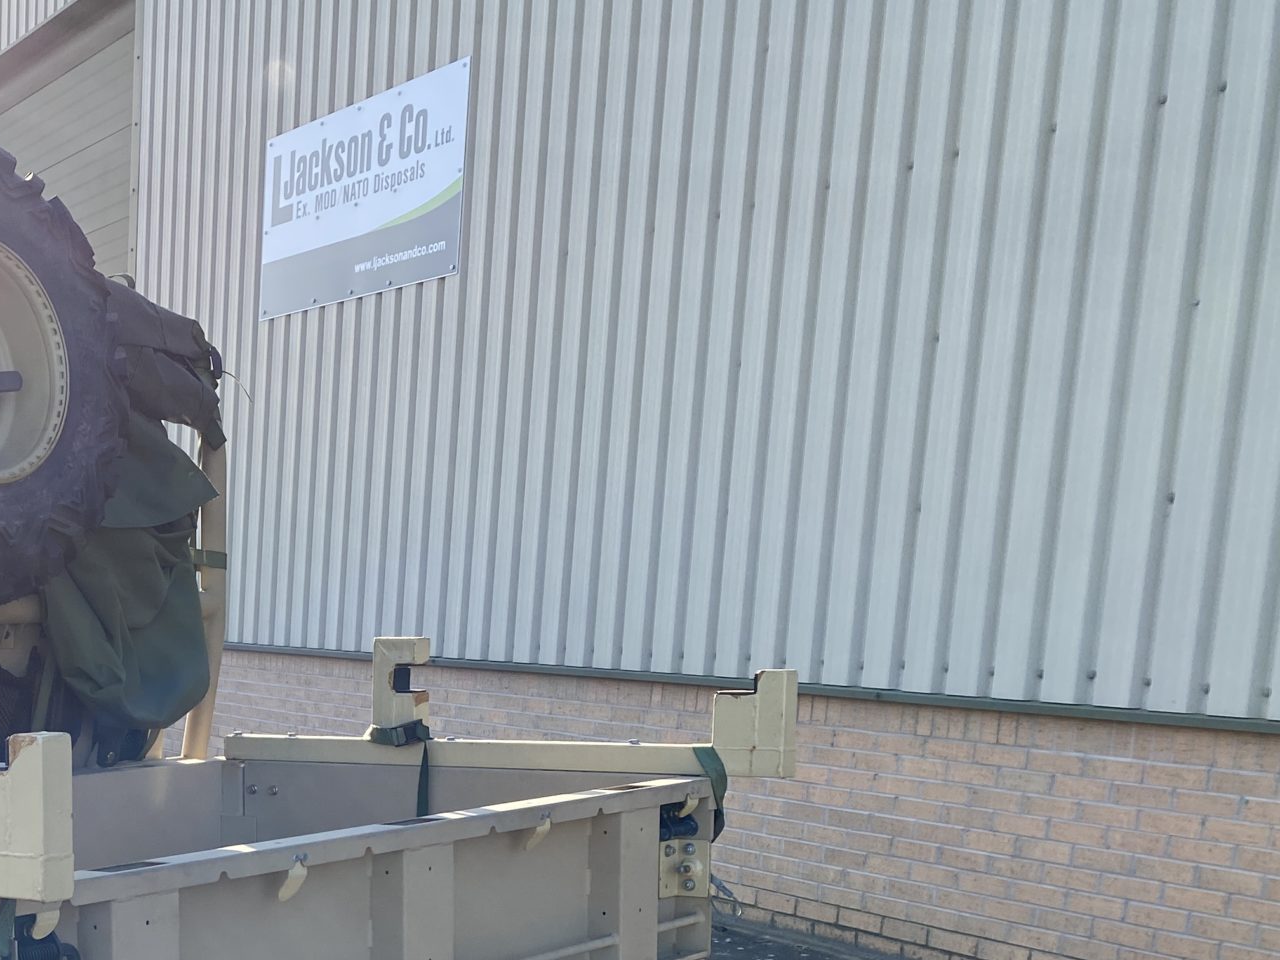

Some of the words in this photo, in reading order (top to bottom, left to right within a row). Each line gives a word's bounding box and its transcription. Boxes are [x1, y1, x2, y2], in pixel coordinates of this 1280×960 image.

[377, 111, 394, 167] &
[398, 103, 432, 160] Co.
[434, 124, 455, 148] Ltd.
[295, 200, 311, 220] Ex.
[372, 159, 426, 194] Disposals
[353, 240, 447, 273] www.ljacksonandco.com
